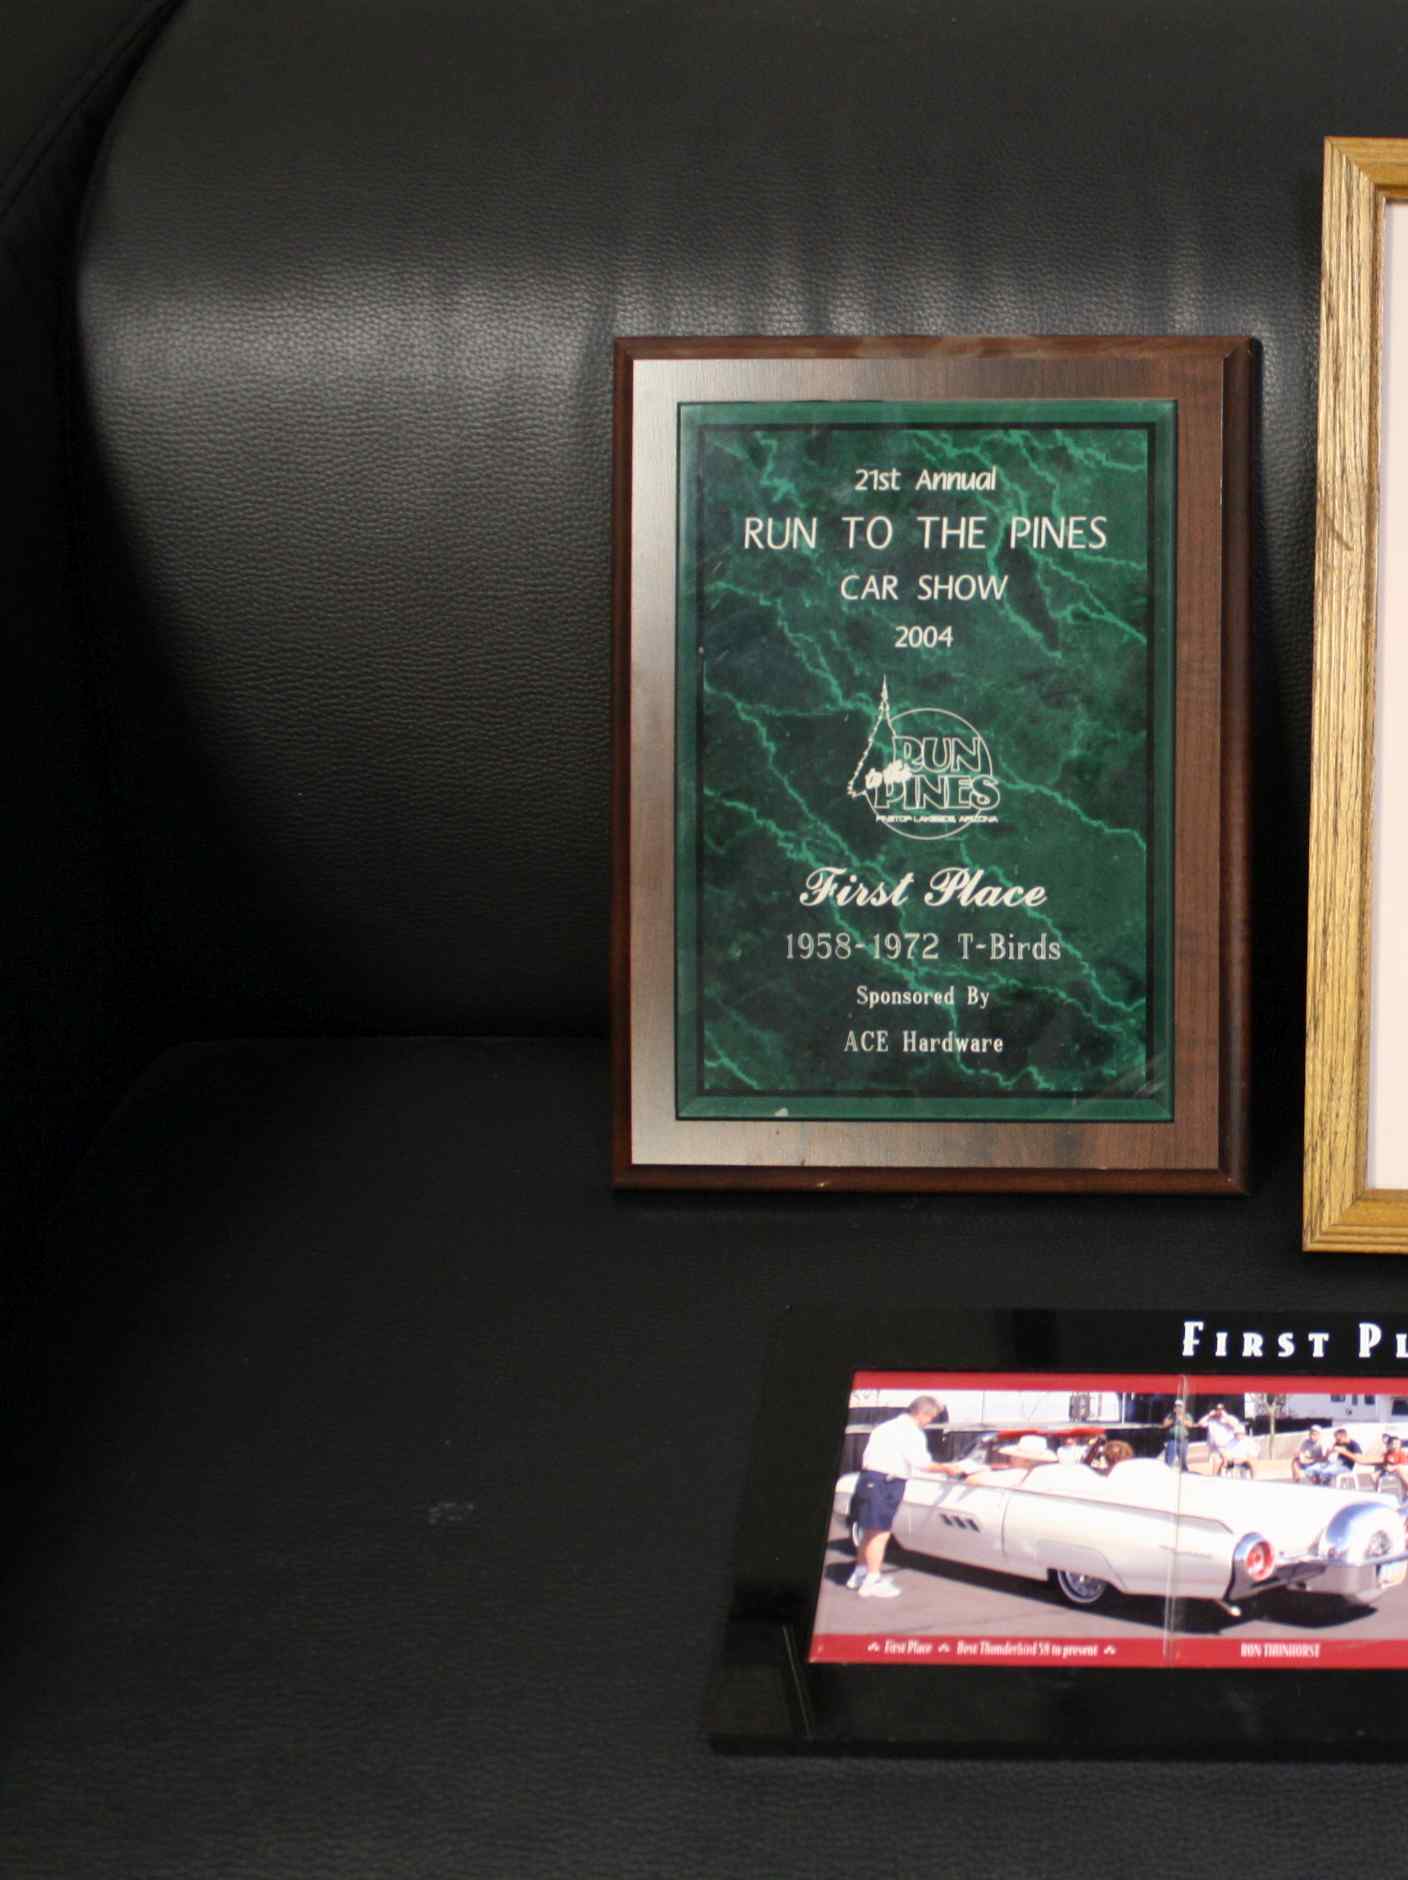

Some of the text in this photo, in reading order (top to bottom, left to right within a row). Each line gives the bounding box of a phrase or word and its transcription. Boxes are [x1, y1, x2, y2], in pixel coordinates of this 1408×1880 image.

[855, 465, 997, 491] 21st Annual
[744, 516, 1108, 550] RUN TO THE PINES
[840, 574, 1009, 600] CAR SHOW
[894, 625, 954, 648] 2004
[892, 736, 981, 774] RUN
[874, 774, 1000, 810] PINES
[799, 866, 1047, 907] First Place
[786, 932, 1062, 960] 1958-1972 T-Birds
[856, 985, 990, 1009] Sponsored By
[844, 1030, 1004, 1052] ACE Hardware
